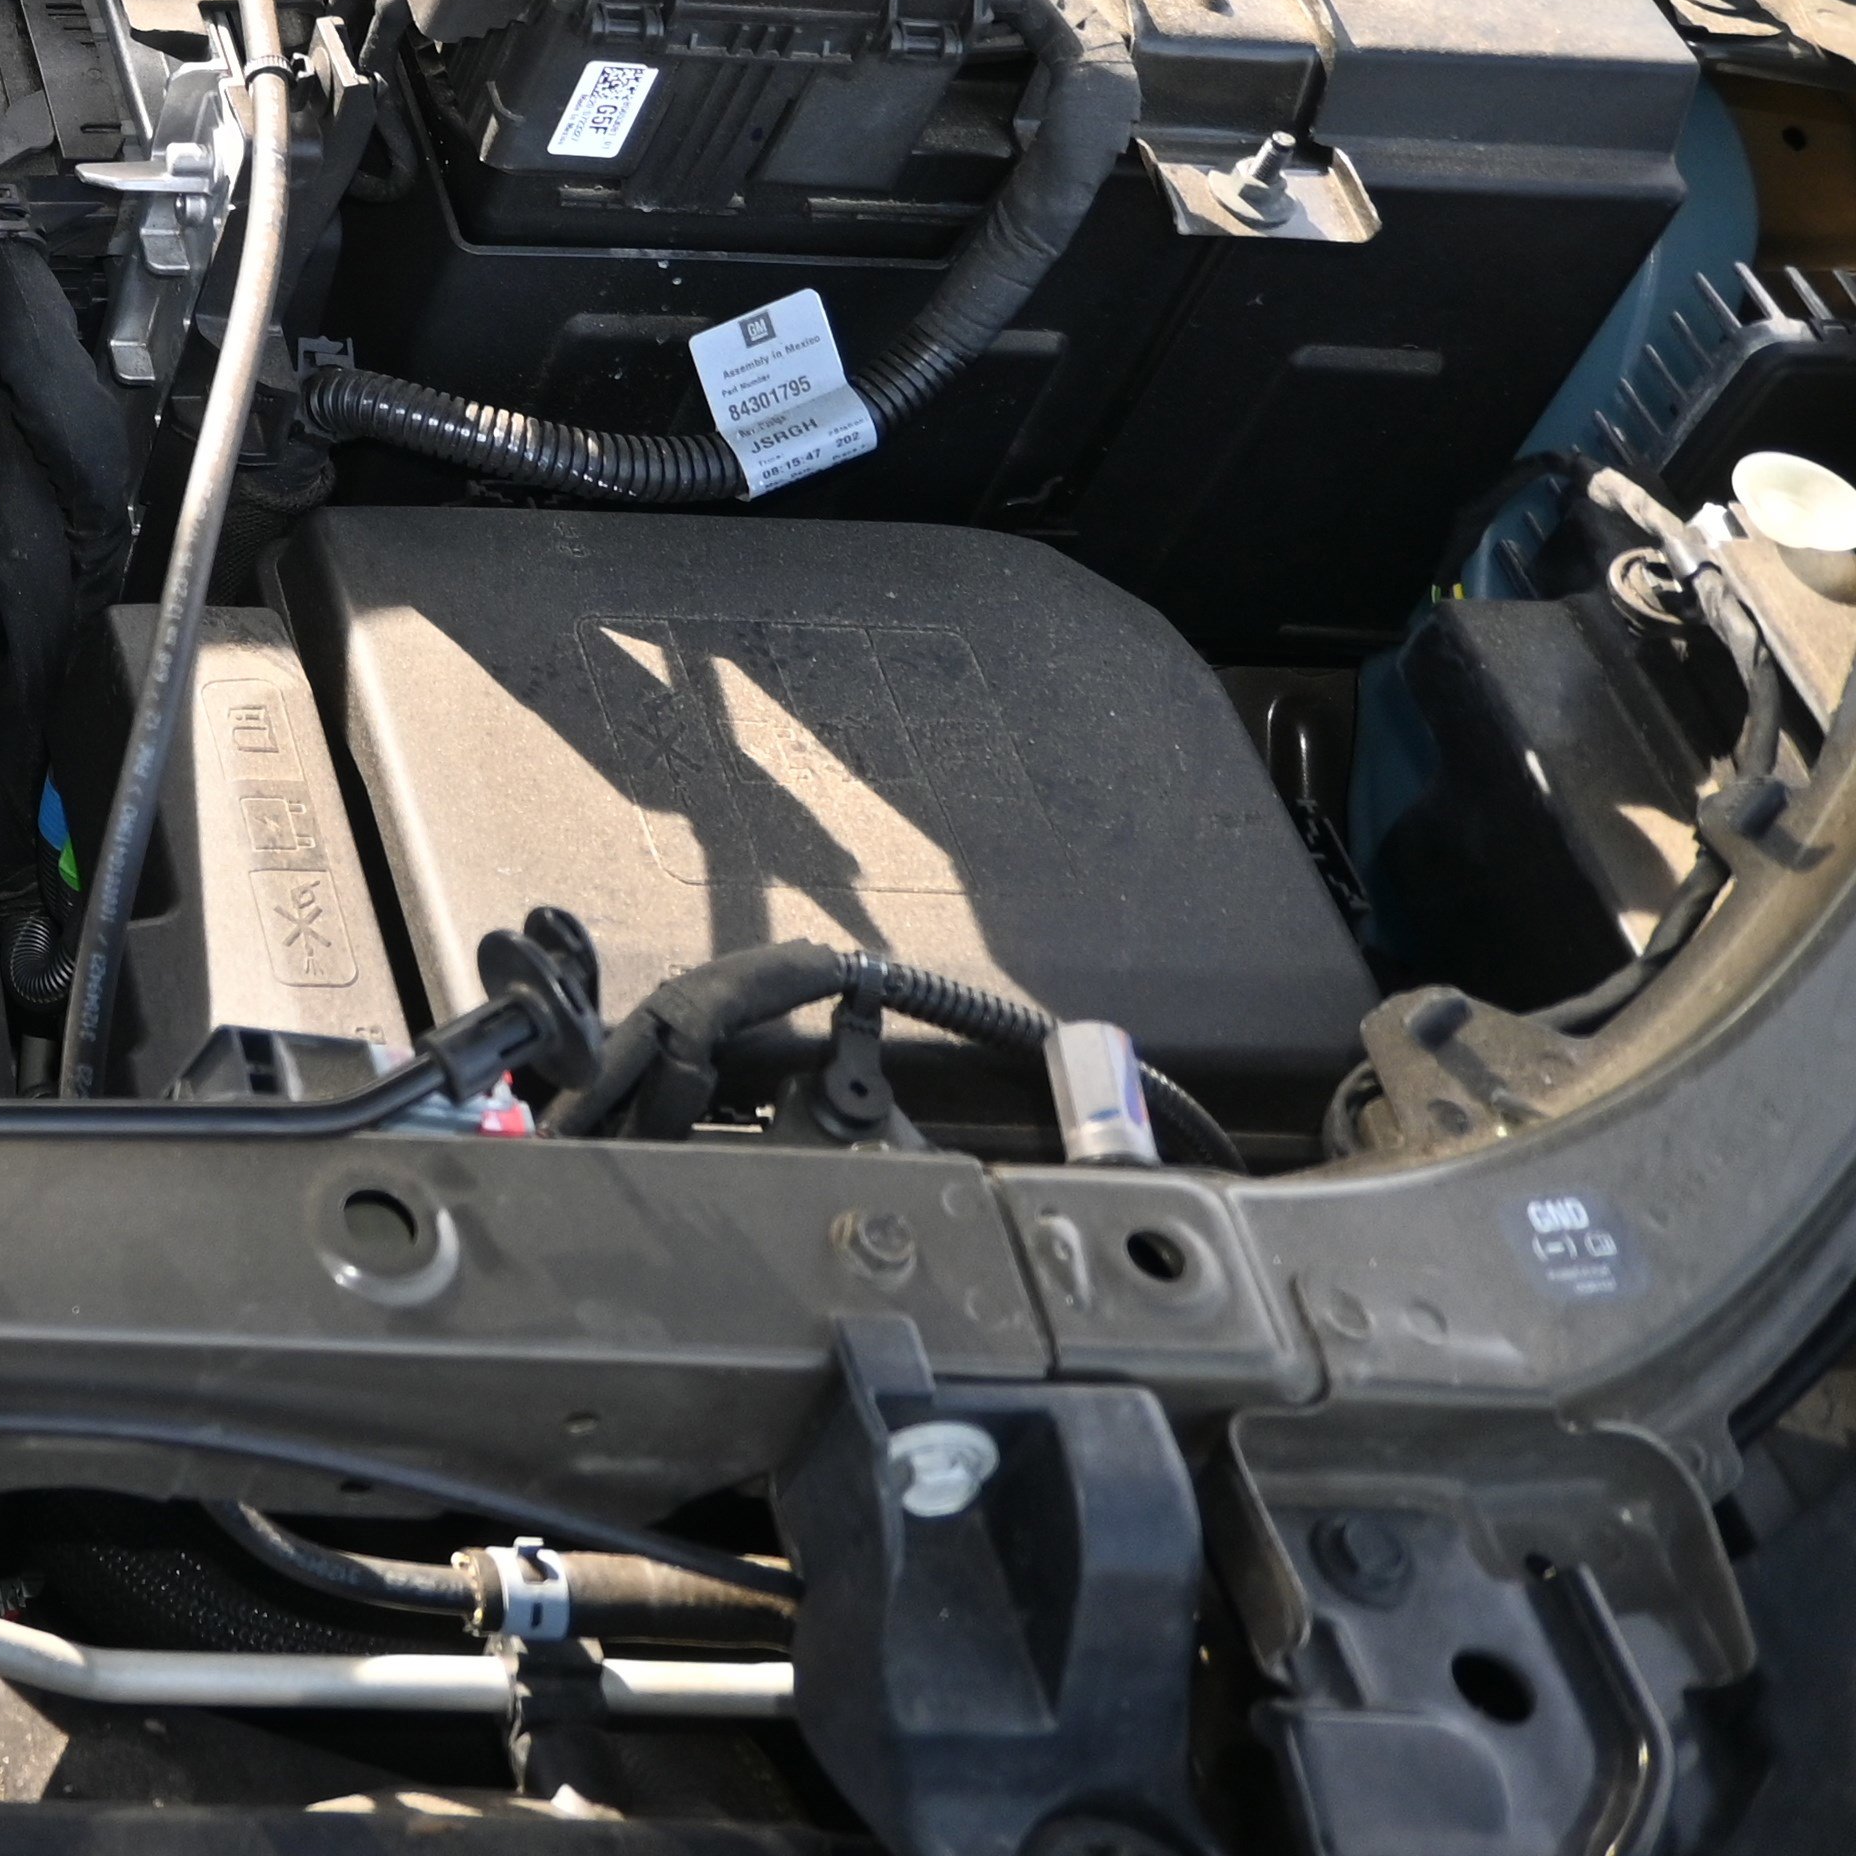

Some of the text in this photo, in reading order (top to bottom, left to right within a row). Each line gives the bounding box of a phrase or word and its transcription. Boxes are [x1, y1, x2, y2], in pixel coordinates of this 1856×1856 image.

[589, 104, 618, 135] G5F
[746, 318, 768, 337] GM
[723, 334, 821, 379] Assembly in Mexico
[740, 373, 771, 389] Number
[727, 375, 812, 420] 84301795
[749, 419, 818, 453] JSRGH
[834, 431, 860, 447] 202
[761, 449, 822, 478] 08:15:47
[1526, 1196, 1590, 1233] GND
